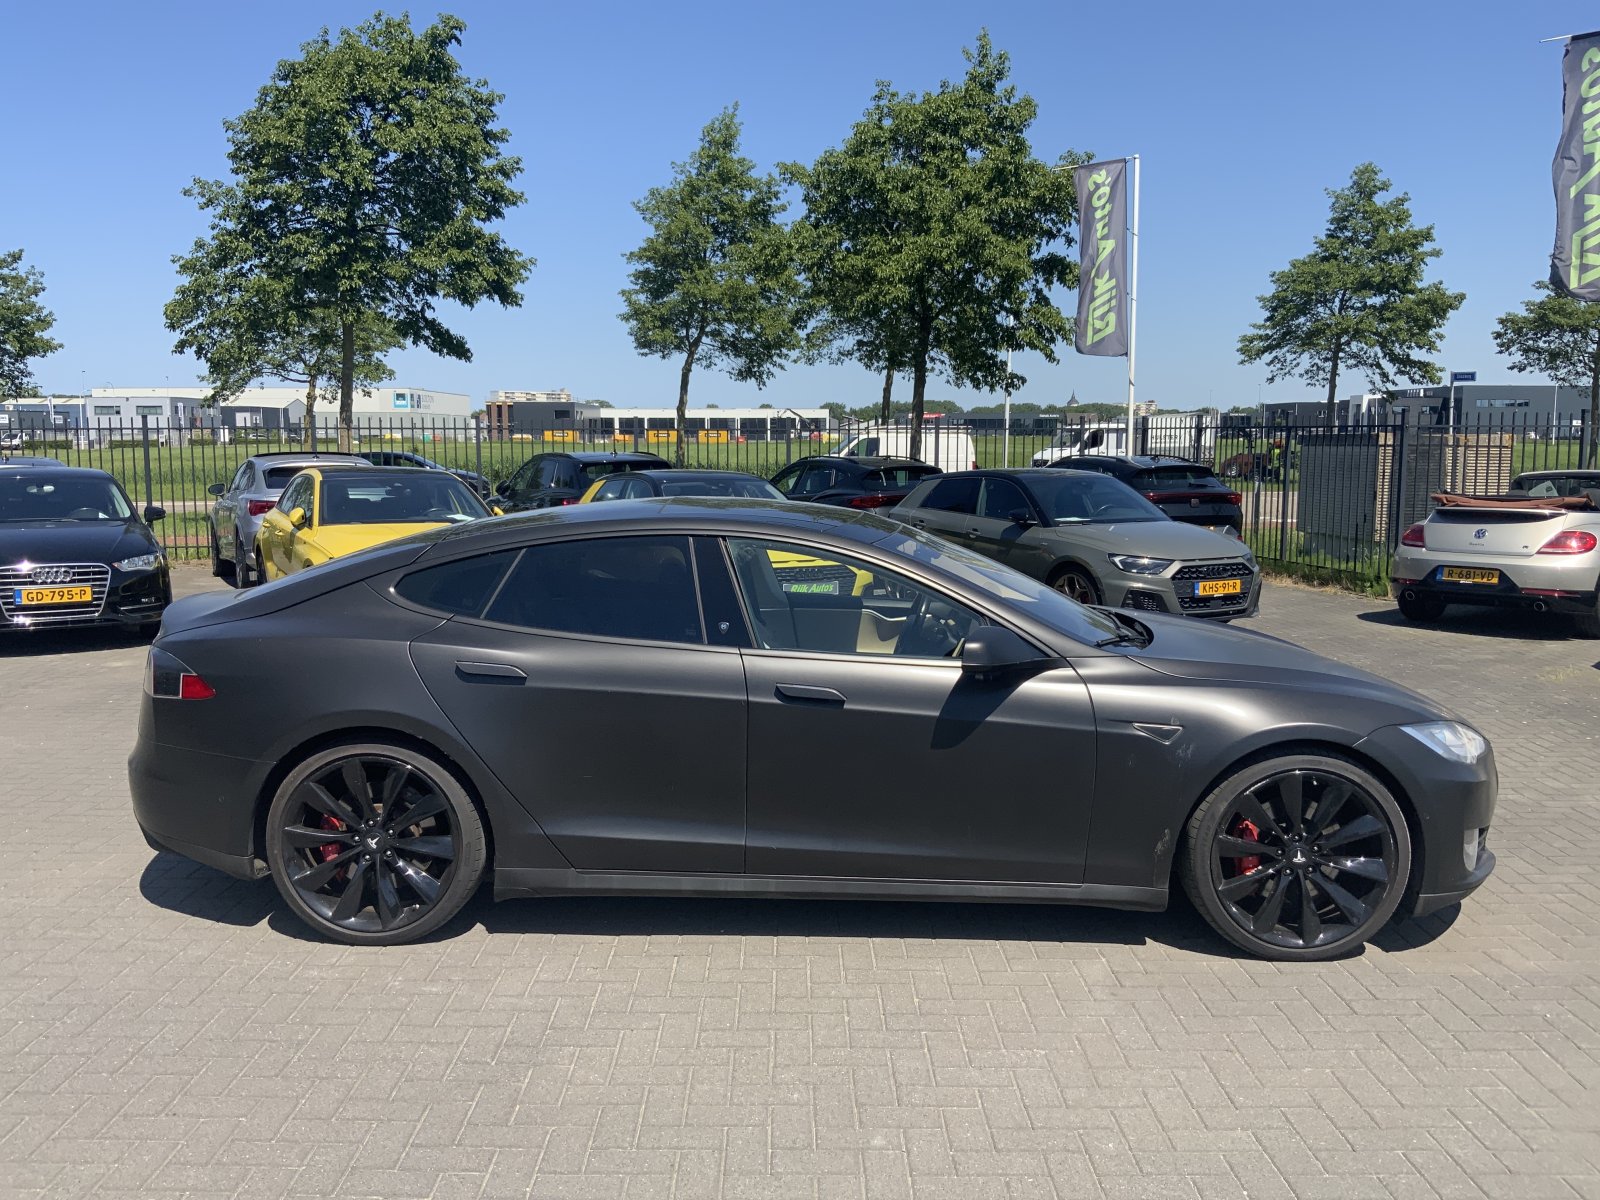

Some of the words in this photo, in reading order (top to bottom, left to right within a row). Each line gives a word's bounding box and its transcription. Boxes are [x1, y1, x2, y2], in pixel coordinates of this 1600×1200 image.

[1447, 569, 1495, 581] R-681-VD
[1202, 582, 1237, 593] KHS-91-R
[26, 589, 87, 602] GD-795-P
